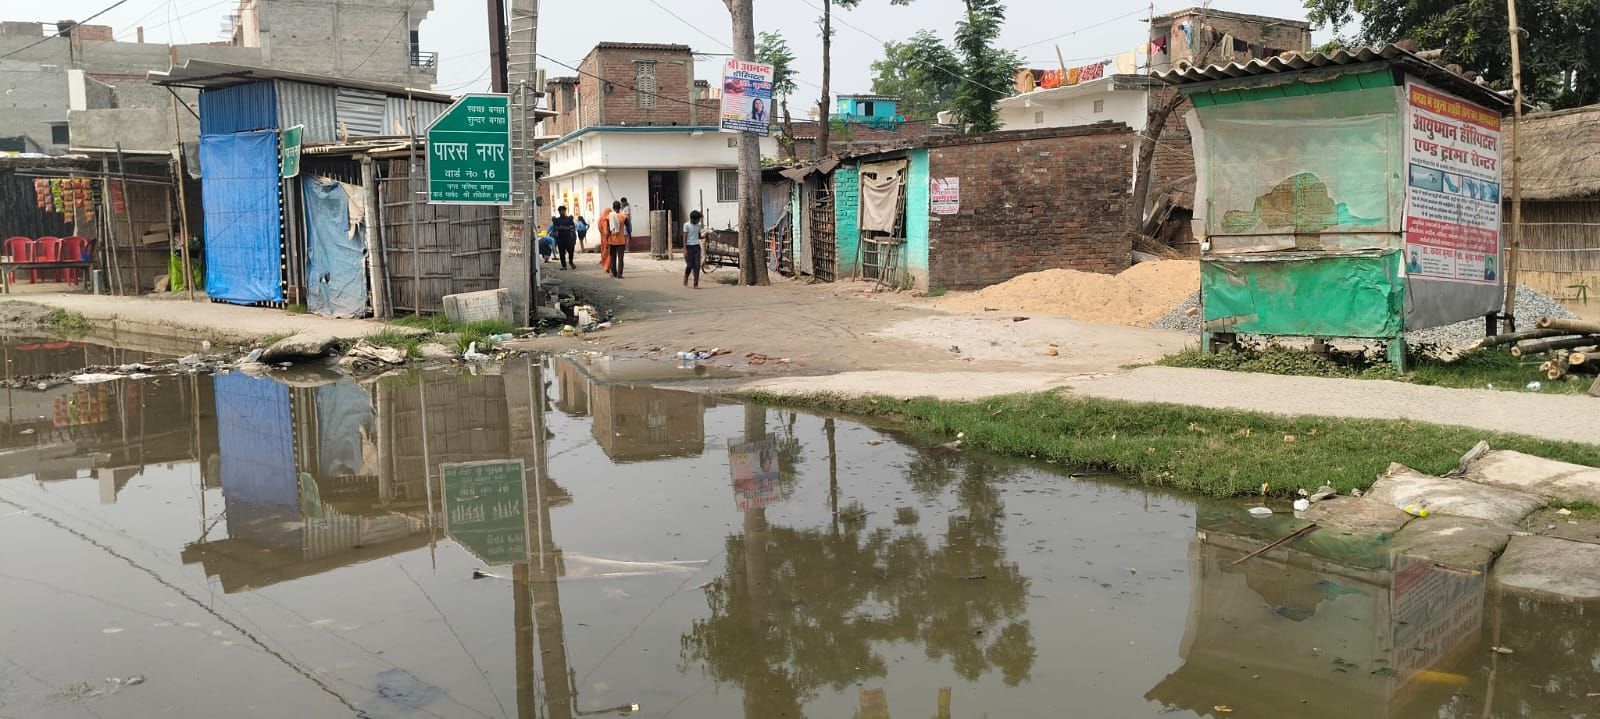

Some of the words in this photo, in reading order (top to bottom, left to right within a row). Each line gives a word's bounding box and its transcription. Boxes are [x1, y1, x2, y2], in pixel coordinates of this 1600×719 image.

[467, 116, 485, 126] सुन्दर
[1413, 114, 1457, 140] आयुष्मान
[433, 143, 468, 160] पारस
[475, 144, 504, 161] नगर
[1413, 138, 1439, 156] एण्ड
[1471, 150, 1496, 170] सेन्टर
[444, 168, 460, 178] वार्ड
[483, 169, 495, 178] 16
